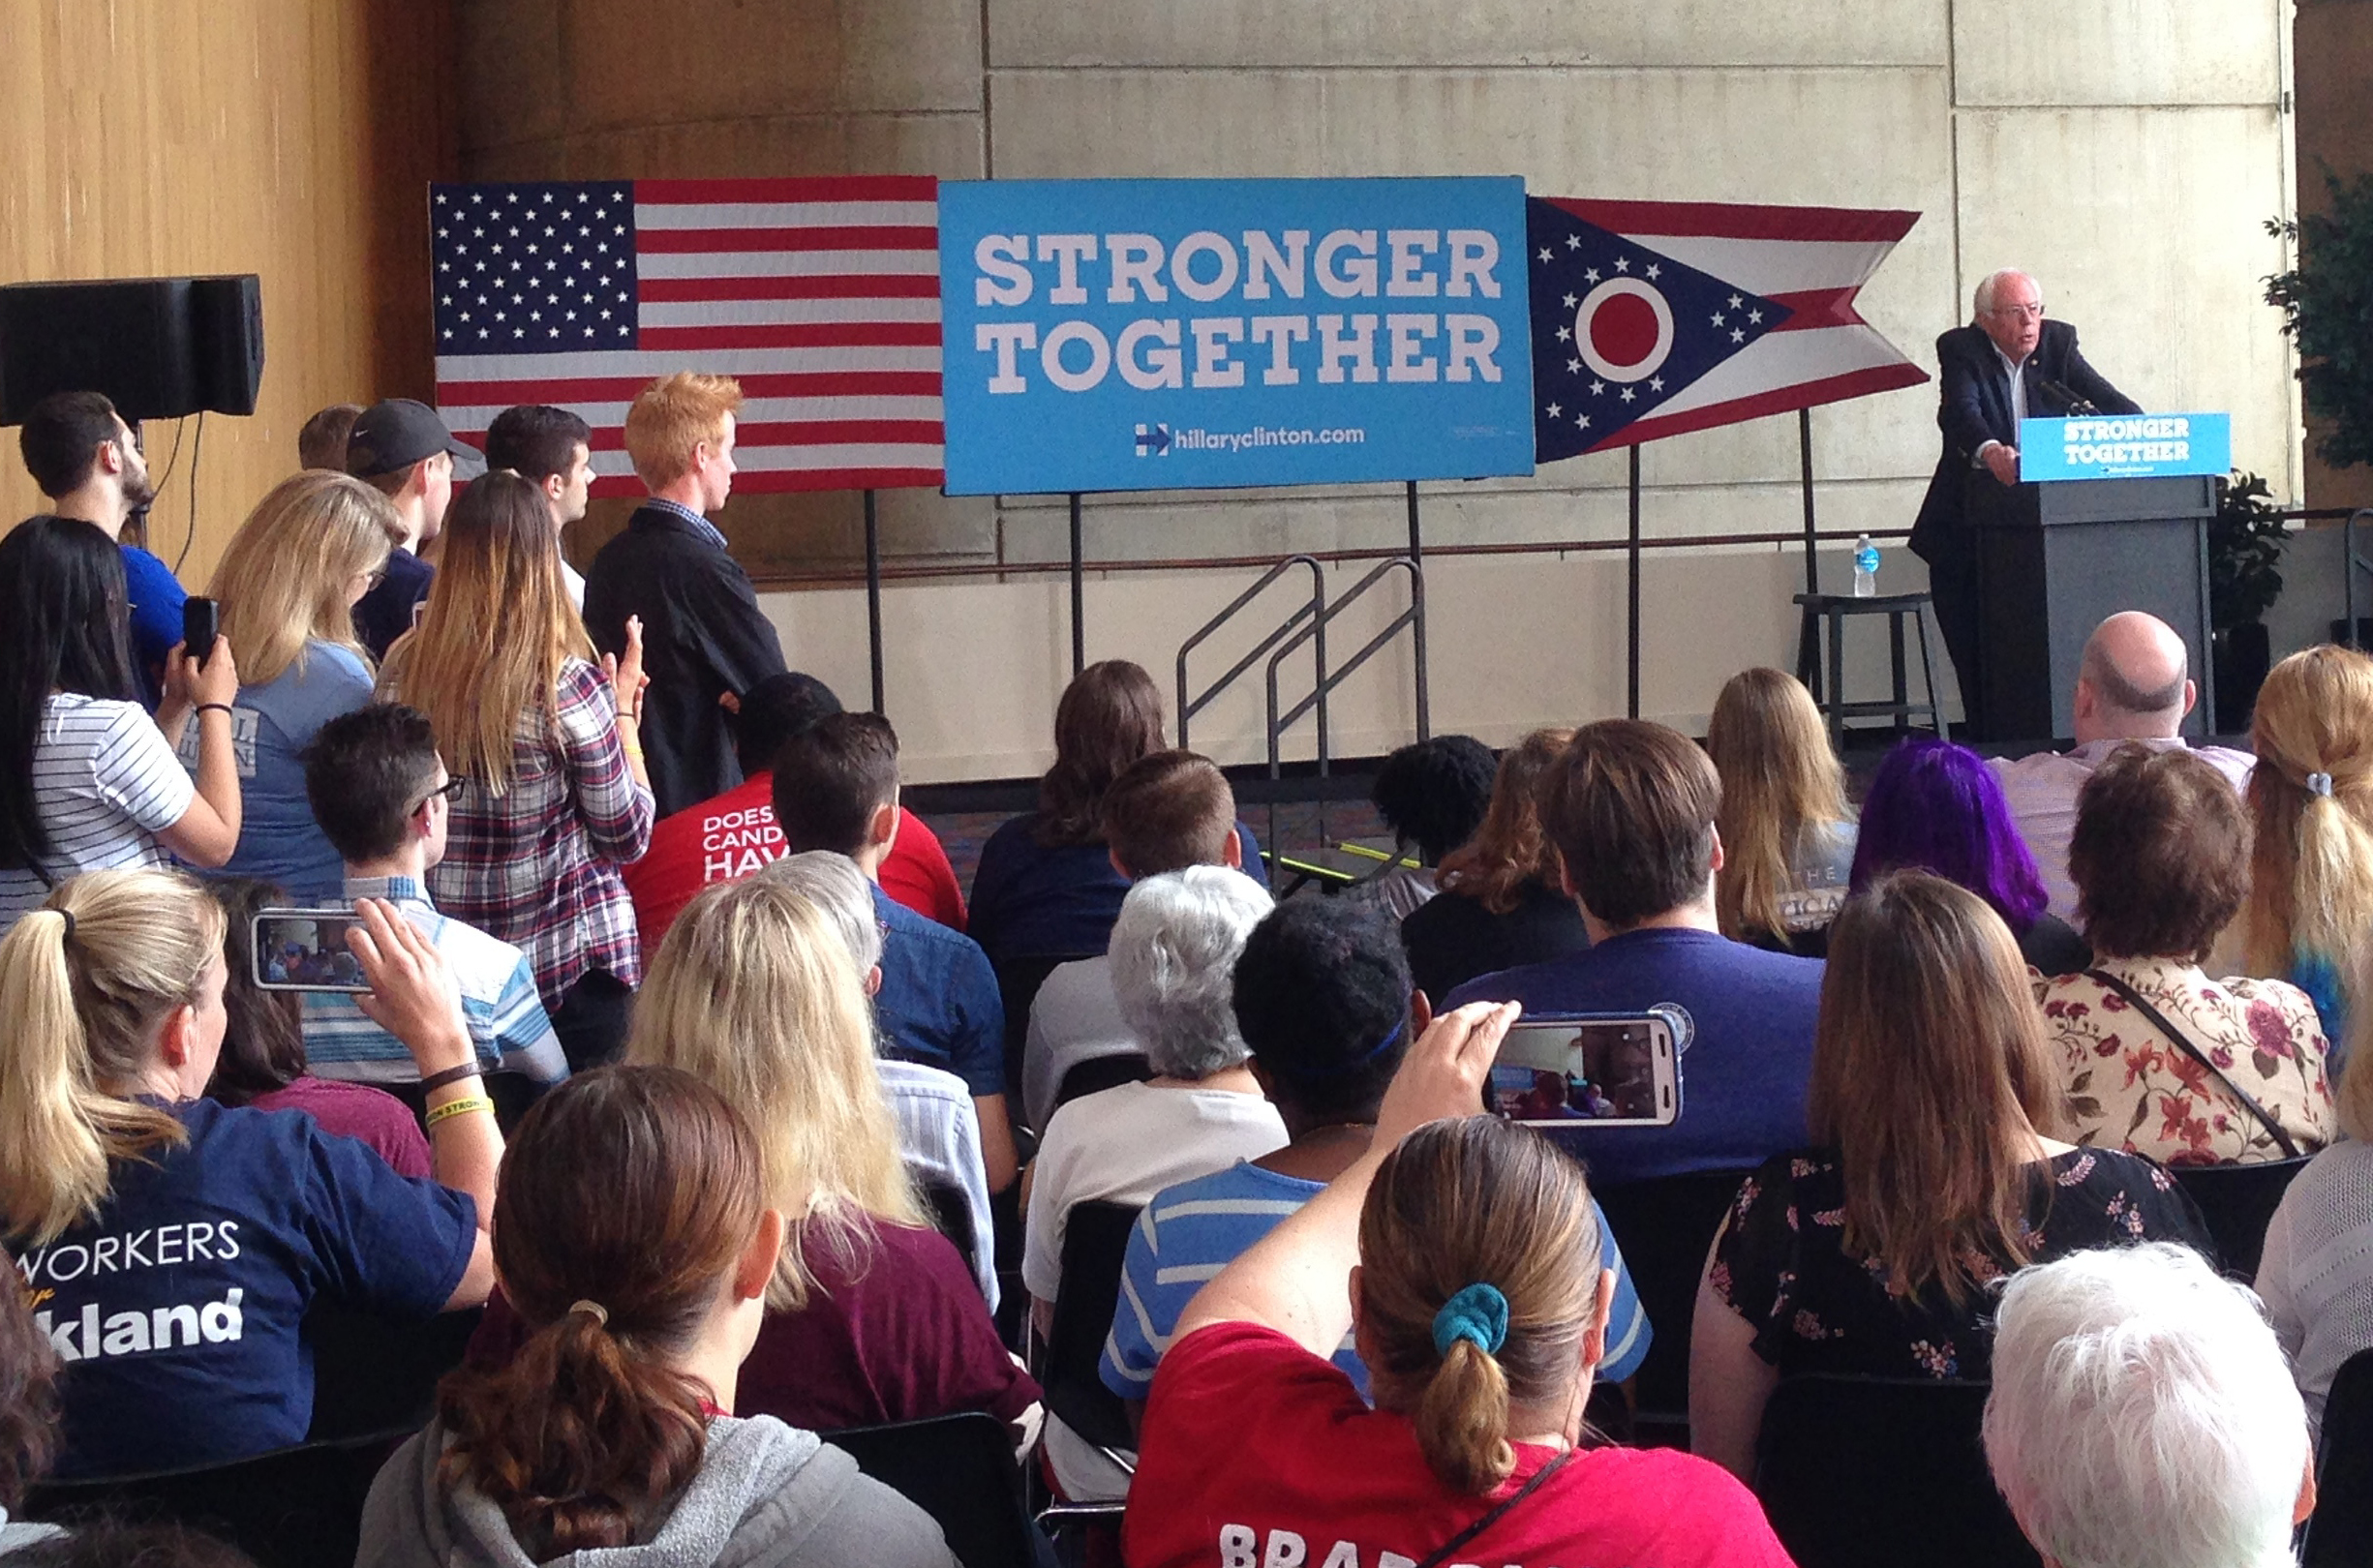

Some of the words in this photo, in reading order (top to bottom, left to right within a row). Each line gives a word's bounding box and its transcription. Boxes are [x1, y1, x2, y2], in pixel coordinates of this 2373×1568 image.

[974, 229, 1502, 306] STRONGER
[975, 315, 1502, 394] TOGETHER
[1175, 427, 1364, 452] hillaryclinton.com
[2064, 418, 2189, 441] STRONGER
[2064, 441, 2189, 465] TOGETHER
[704, 805, 774, 832] DOES
